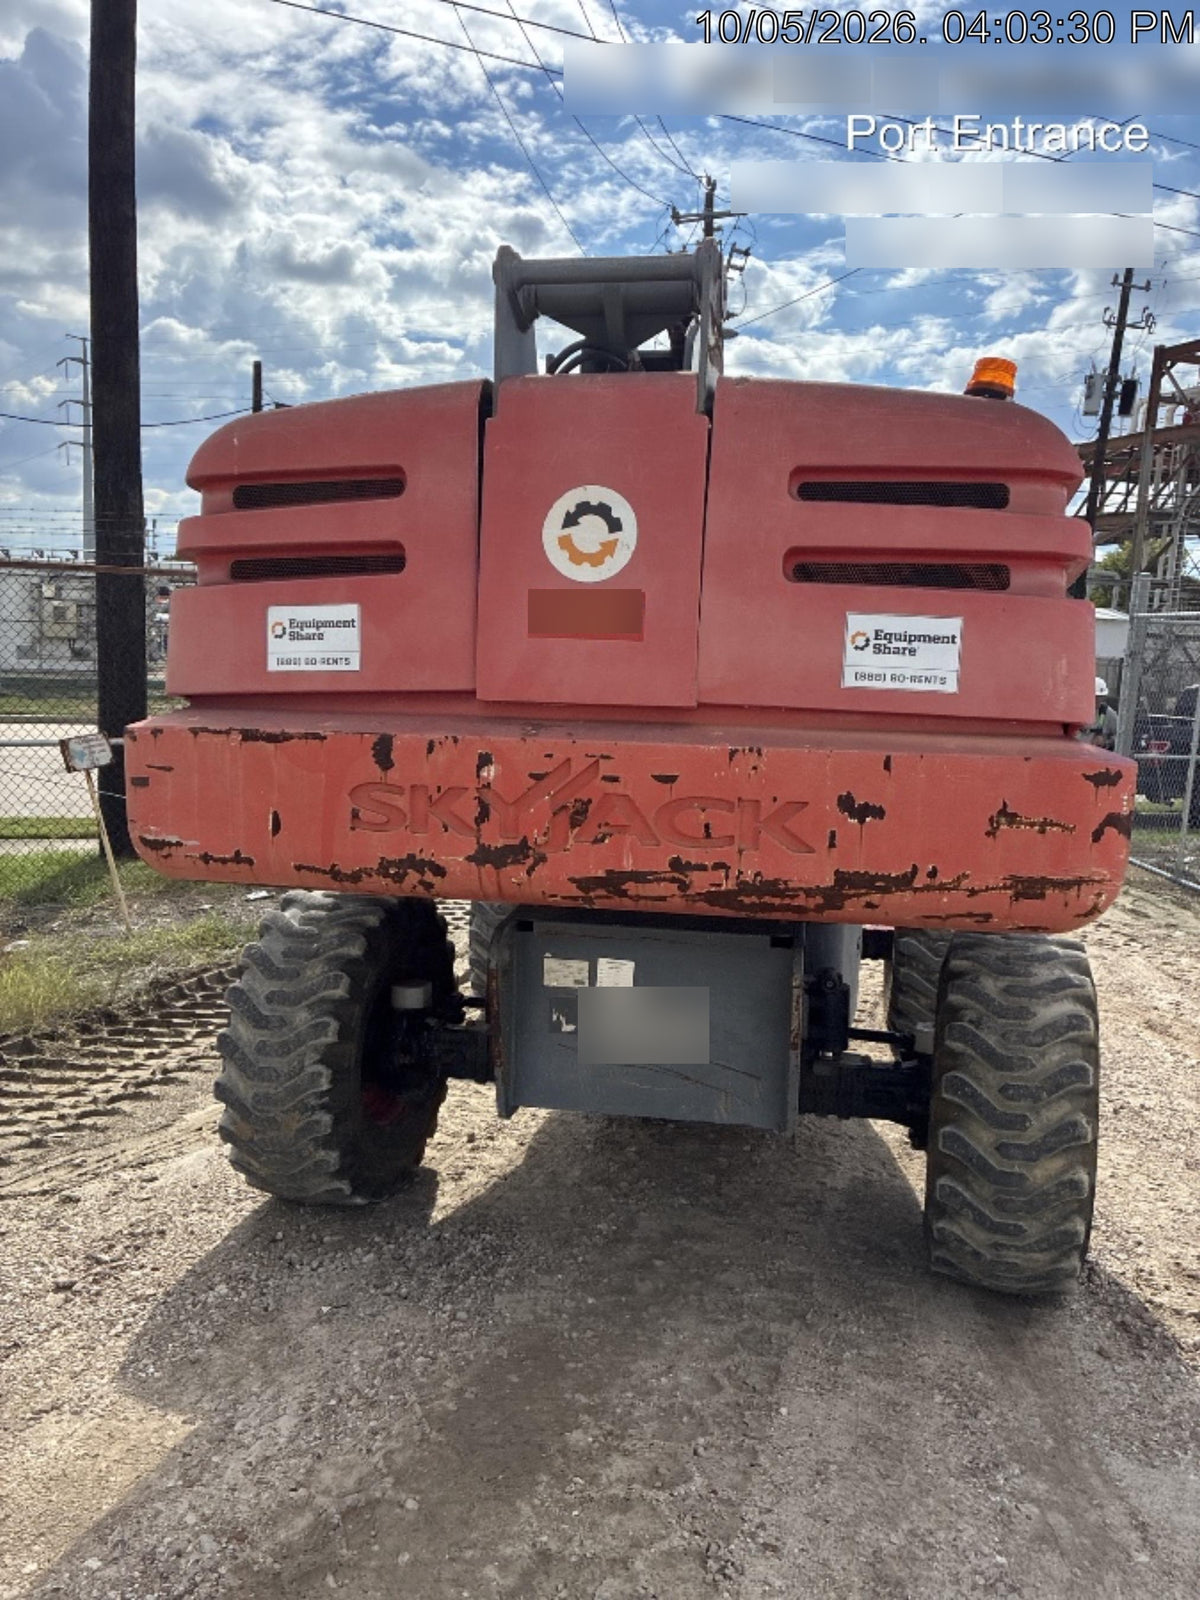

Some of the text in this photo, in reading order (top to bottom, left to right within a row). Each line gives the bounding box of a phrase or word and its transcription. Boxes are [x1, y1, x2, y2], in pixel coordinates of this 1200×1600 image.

[288, 618, 356, 631] Equipment
[288, 631, 325, 641] Share
[873, 629, 957, 645] Equipment
[872, 643, 918, 656] Share
[348, 757, 815, 853] SKYJACK
